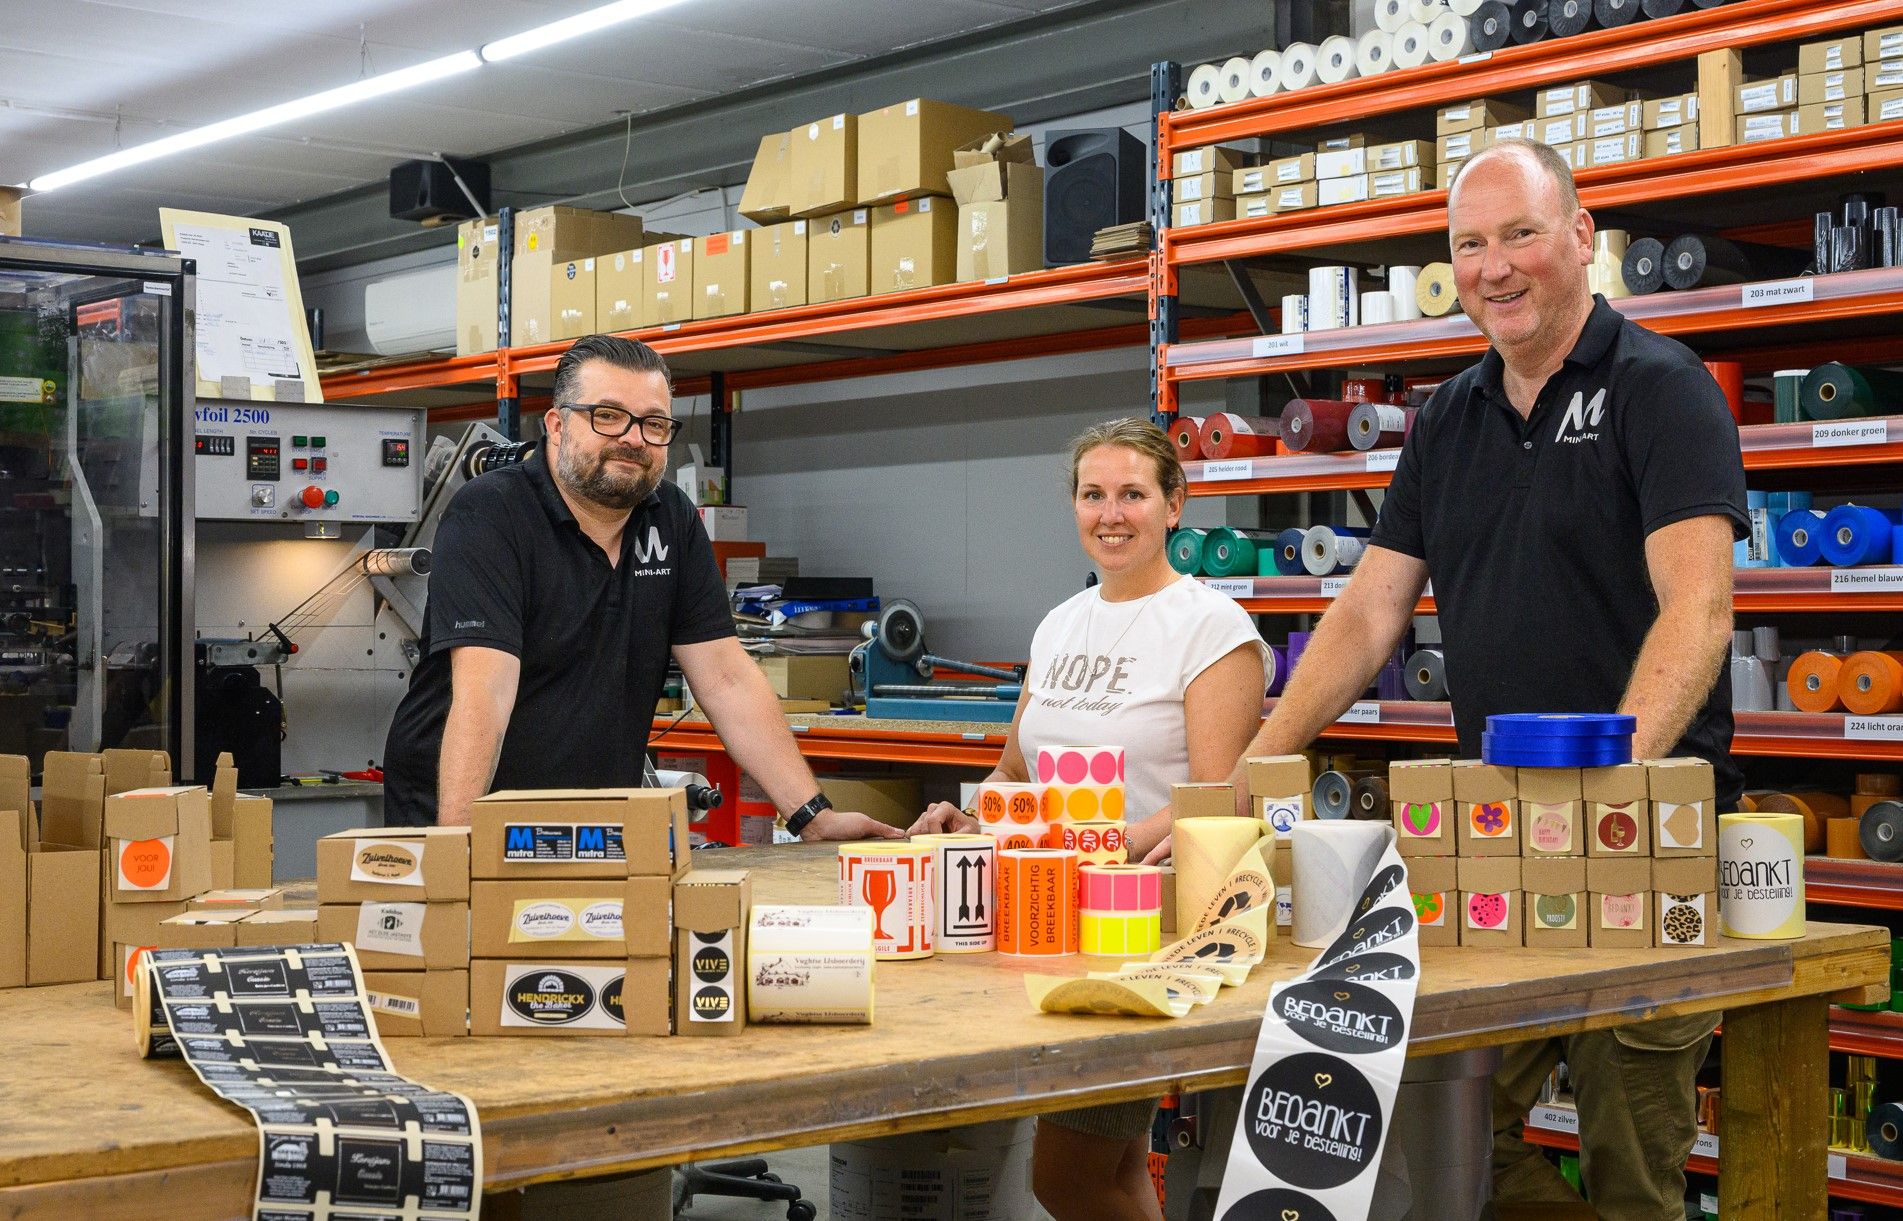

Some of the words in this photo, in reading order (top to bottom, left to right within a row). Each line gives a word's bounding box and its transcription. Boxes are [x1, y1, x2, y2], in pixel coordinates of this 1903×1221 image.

[1750, 289, 1764, 298] 203
[1766, 288, 1781, 297] mat
[1783, 285, 1805, 296] zwart
[1268, 341, 1278, 349] 201
[1278, 340, 1288, 348] wit
[233, 408, 270, 424] 2500
[1814, 430, 1829, 438] 209
[1831, 428, 1860, 437] donker
[1862, 428, 1885, 438] groen
[1379, 453, 1399, 461] bordea
[634, 568, 672, 576] MINI-ART
[1851, 574, 1876, 583] hemel
[1878, 574, 1903, 583] blauw
[1232, 584, 1248, 592] groen
[455, 620, 485, 629] hummel
[1042, 697, 1076, 708] not
[1072, 696, 1123, 716] today
[1867, 722, 1885, 730] licht
[984, 796, 1002, 812] 50%
[1014, 798, 1034, 813] 50%
[133, 854, 158, 862] VOOR
[362, 853, 412, 866] Zuivelhoeve
[508, 850, 534, 858] mitra
[578, 850, 605, 858] mitra
[136, 863, 154, 874] JOU!
[1208, 886, 1228, 910] LEVEN
[1734, 889, 1742, 900] je
[1748, 887, 1793, 900] bestelling!
[1030, 864, 1040, 947] VOORZICHTIG
[1046, 868, 1056, 944] BREEKBAAR
[523, 912, 570, 925] Zuivelhoeve
[1186, 930, 1214, 945] LEVEN
[696, 959, 727, 970] VIVE
[518, 994, 584, 1004] HENDRICKX
[696, 997, 728, 1008] VIVE
[545, 1002, 572, 1010] Baker
[1284, 1009, 1309, 1022] voor
[1314, 1018, 1327, 1029] je
[1332, 1023, 1388, 1043] bestelling!
[1545, 1112, 1556, 1122] 402
[1558, 1113, 1576, 1124] zilver
[1256, 1120, 1282, 1139] voor
[1285, 1129, 1300, 1142] je
[1304, 1135, 1363, 1158] bestelling!
[1696, 1140, 1712, 1148] rons
